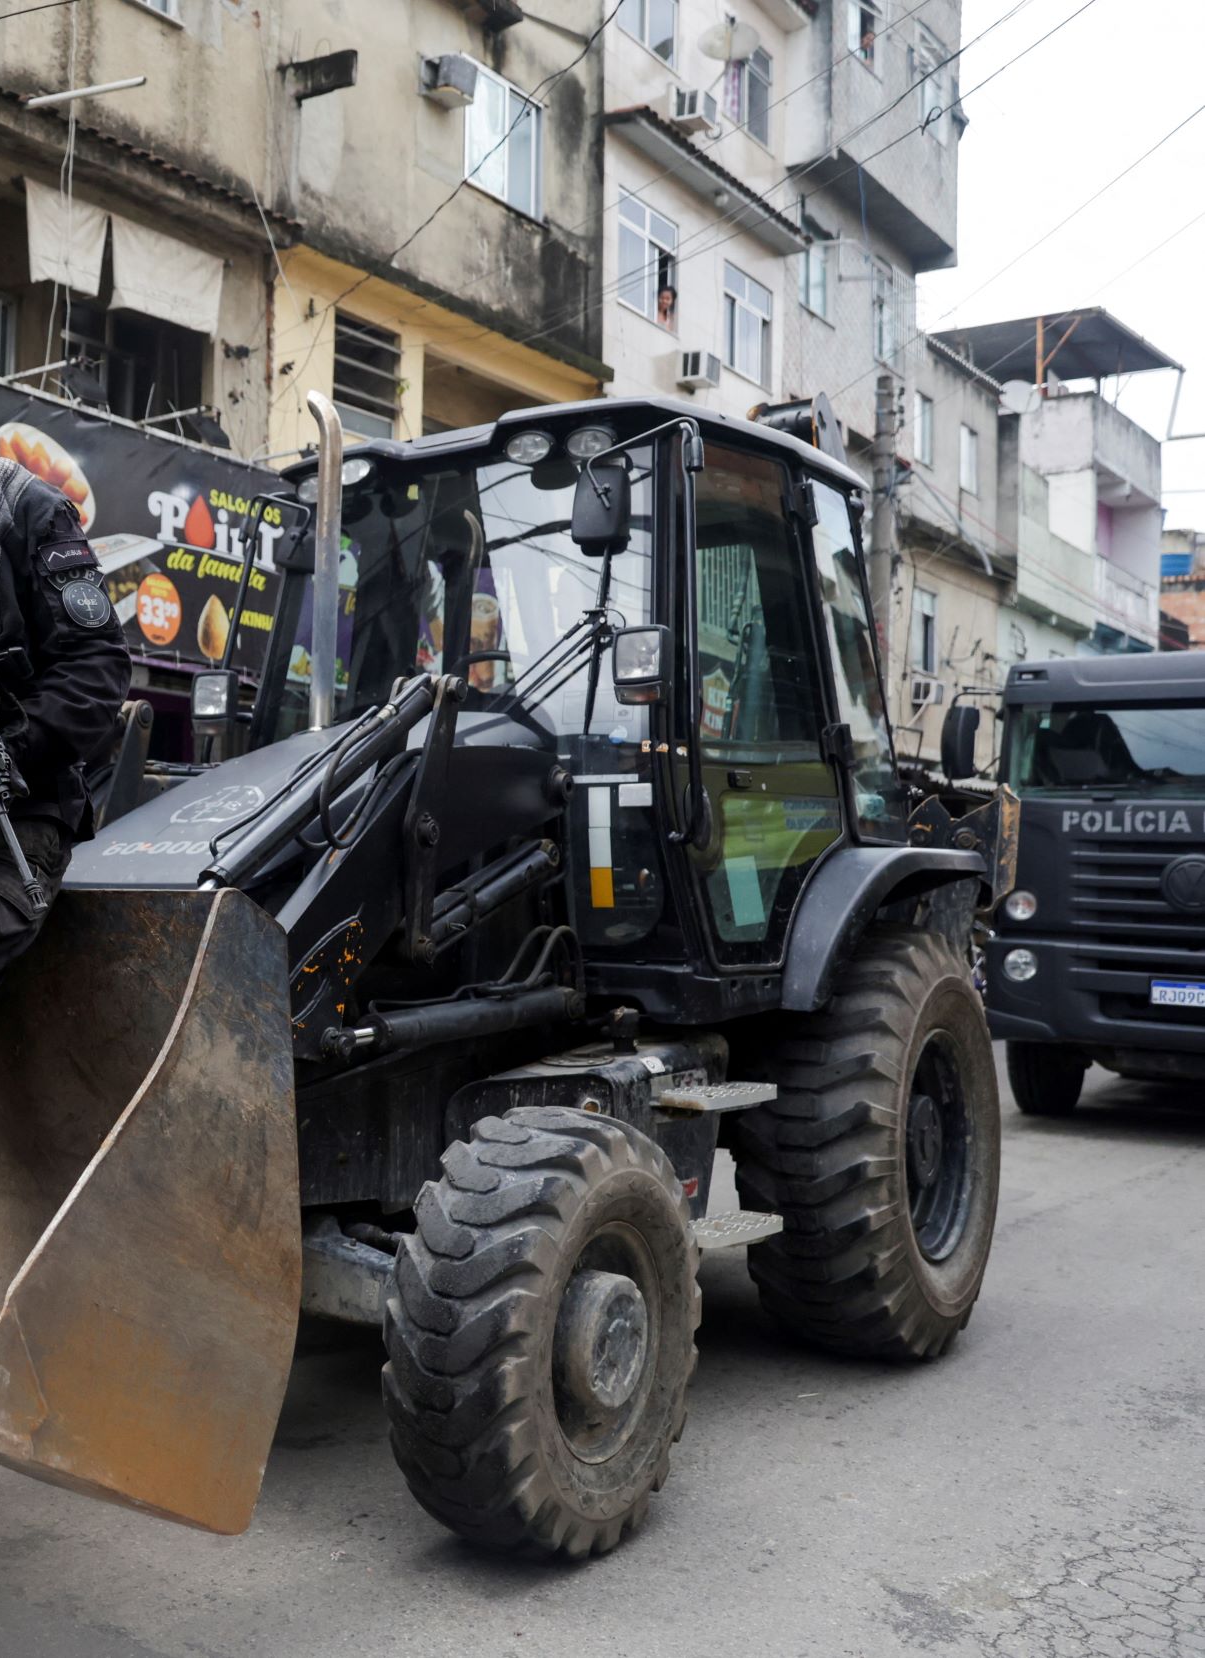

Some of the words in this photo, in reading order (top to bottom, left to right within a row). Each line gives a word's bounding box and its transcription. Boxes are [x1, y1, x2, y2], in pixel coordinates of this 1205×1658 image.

[167, 548, 195, 572] da
[55, 568, 95, 584] COE
[1062, 806, 1192, 834] POLÍCIA
